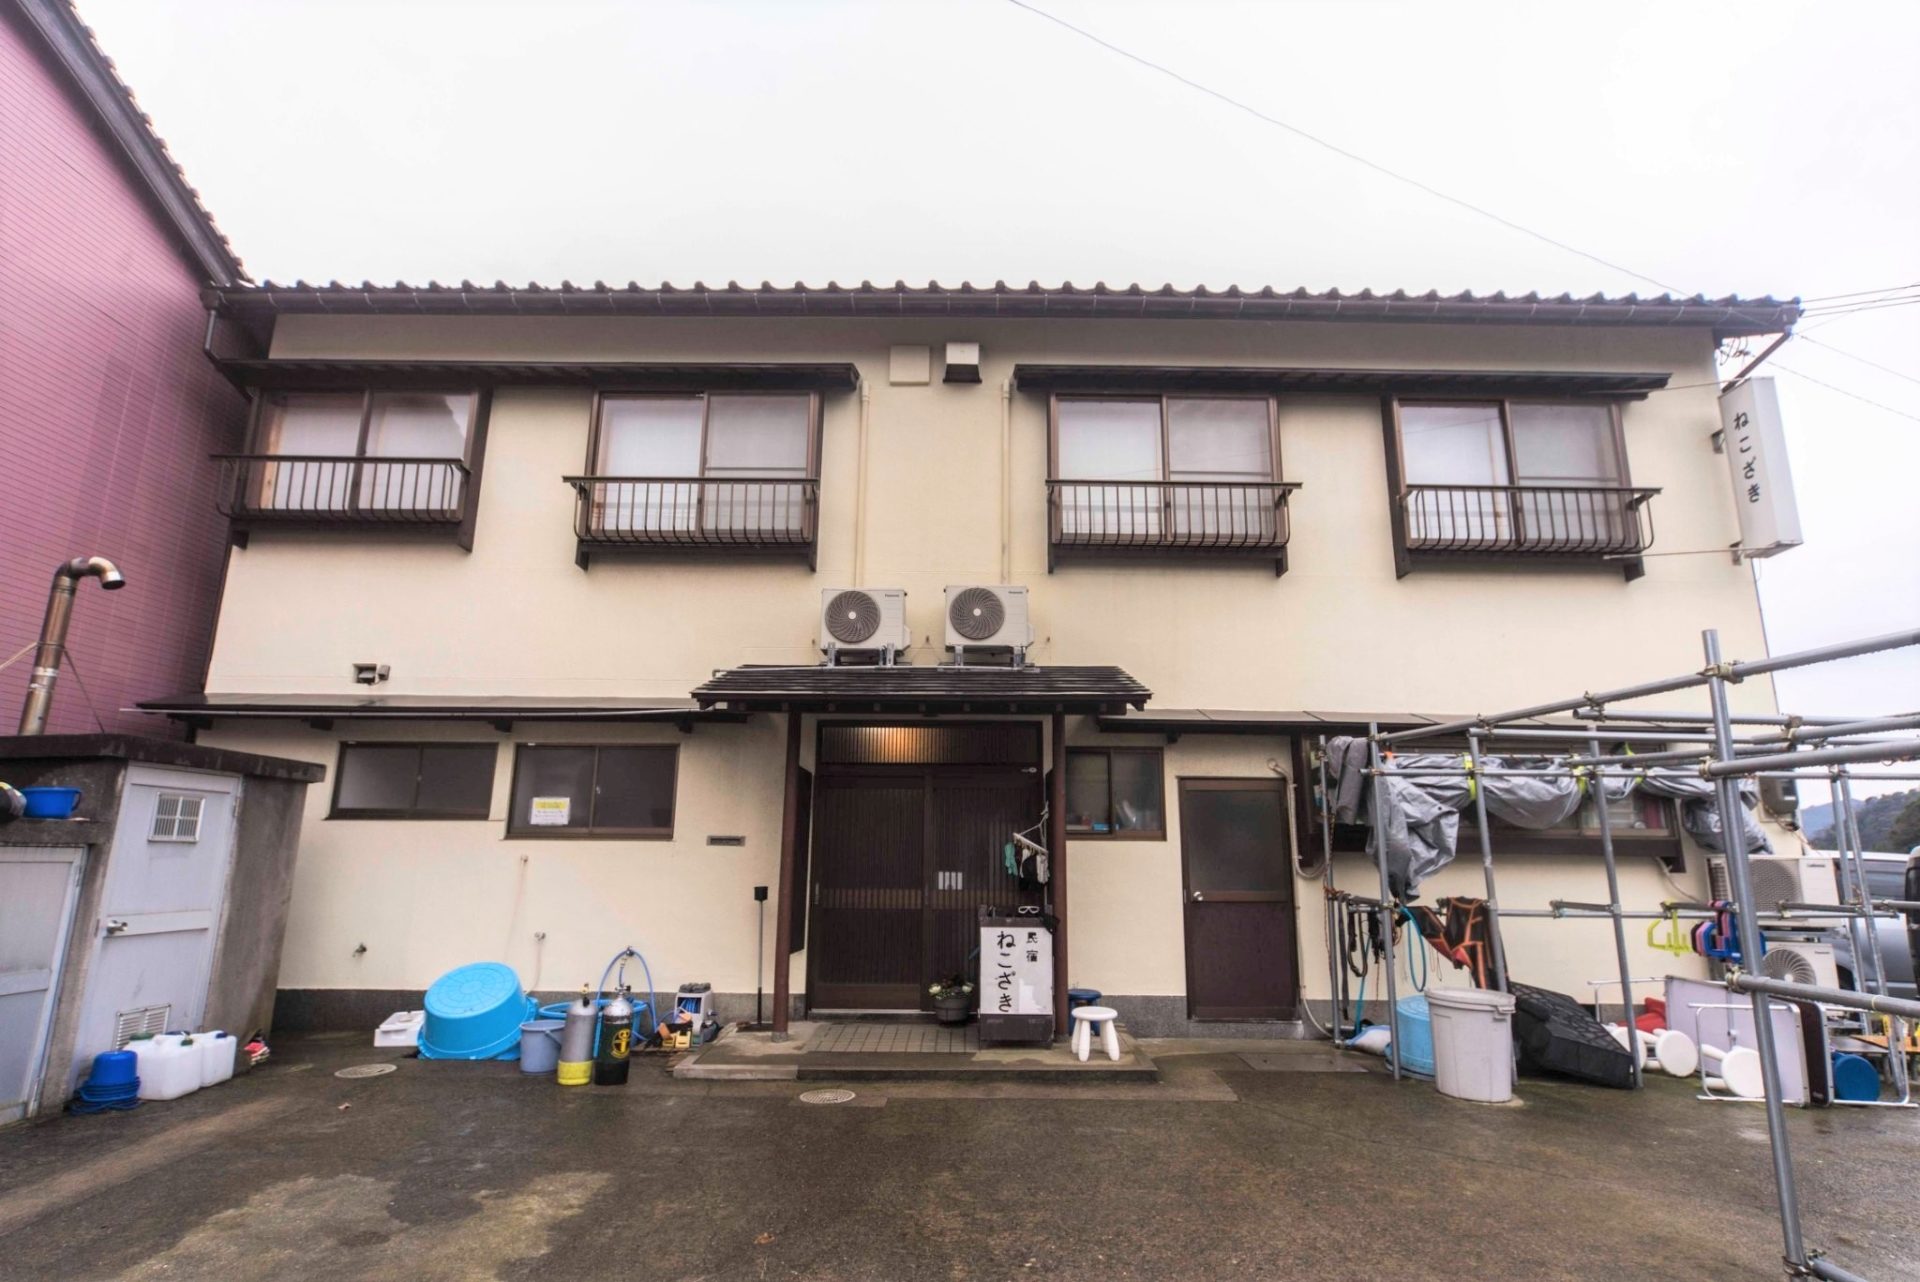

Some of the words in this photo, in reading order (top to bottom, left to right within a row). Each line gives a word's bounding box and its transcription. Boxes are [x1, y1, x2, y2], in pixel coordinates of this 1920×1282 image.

[1733, 411, 1761, 504] ねこざき
[996, 930, 1017, 1013] ねこざき
[1025, 931, 1039, 963] 民宿
